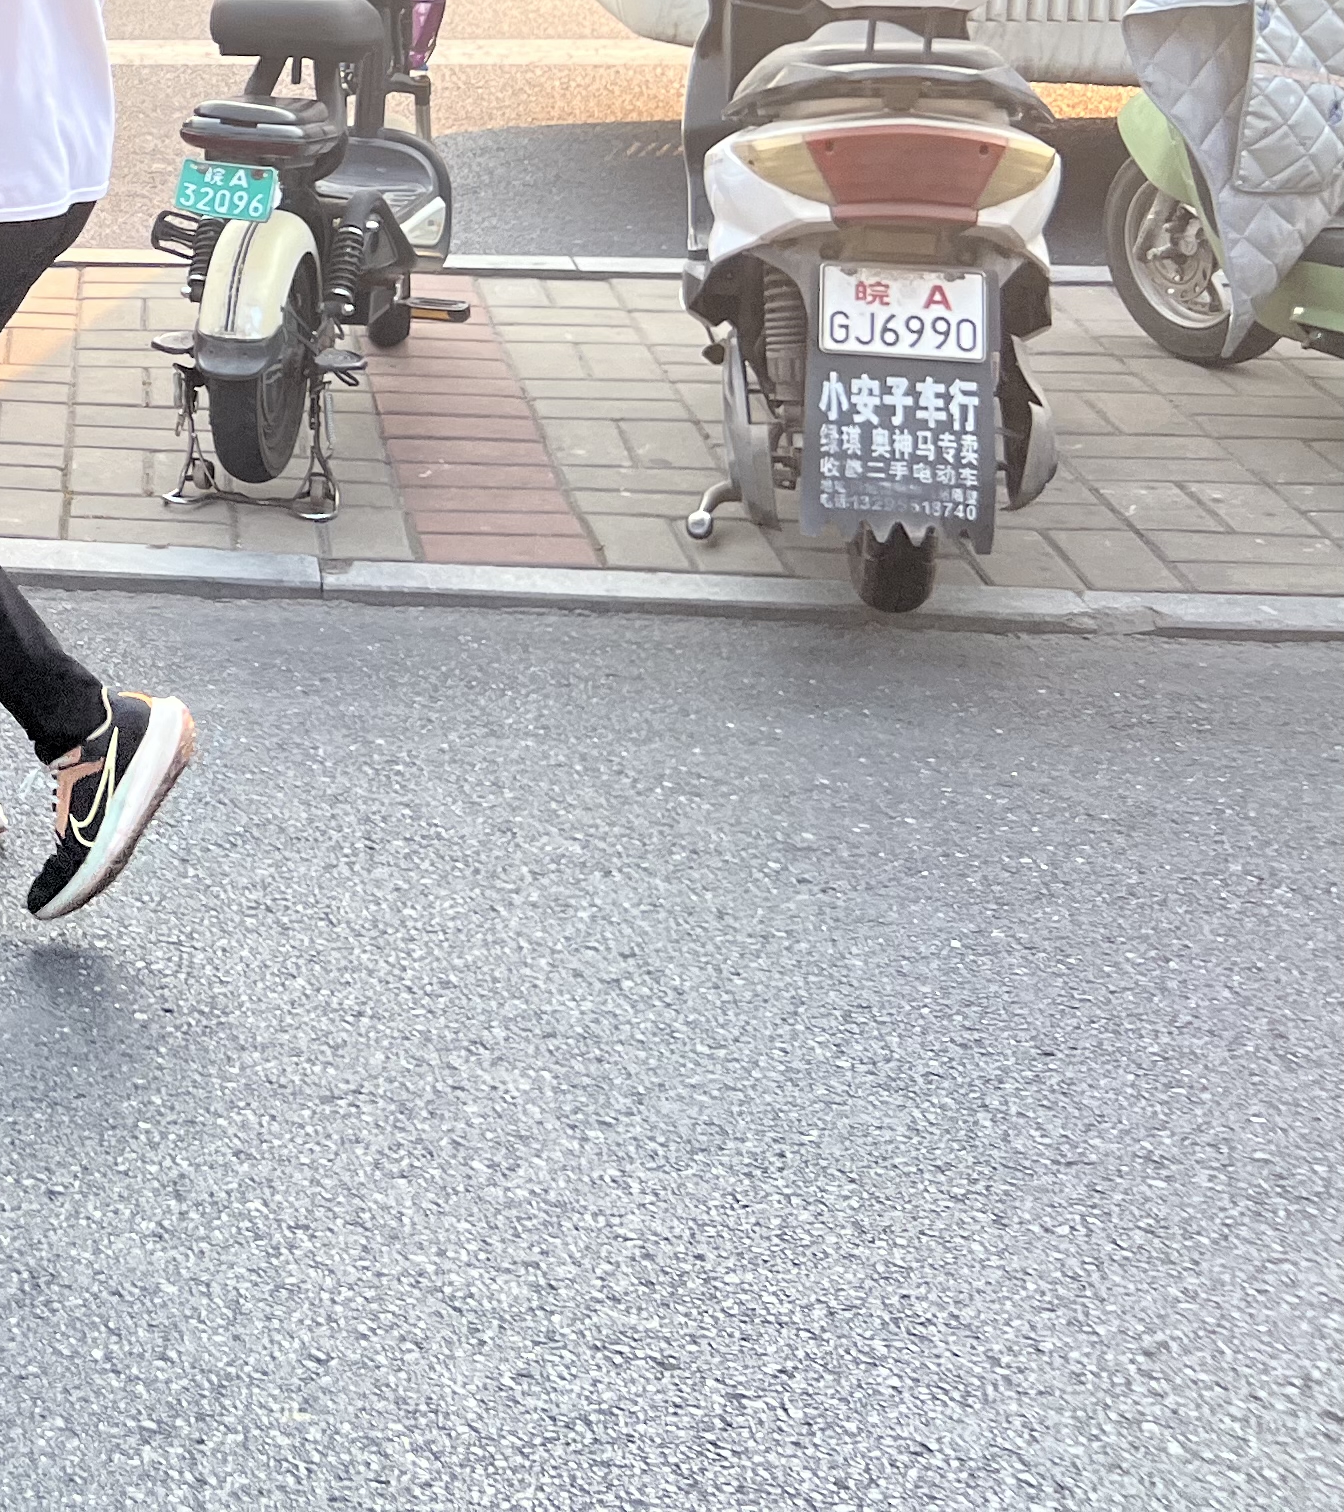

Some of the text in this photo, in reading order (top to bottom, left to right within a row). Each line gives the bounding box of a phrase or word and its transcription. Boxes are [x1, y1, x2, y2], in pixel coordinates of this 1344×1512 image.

[204, 167, 248, 188] 皖 A
[179, 182, 264, 217] 32096
[854, 280, 952, 311] 皖 A
[829, 311, 977, 352] GJ6990
[818, 371, 979, 432] 小安子车行
[871, 427, 979, 465] 奥神马专卖
